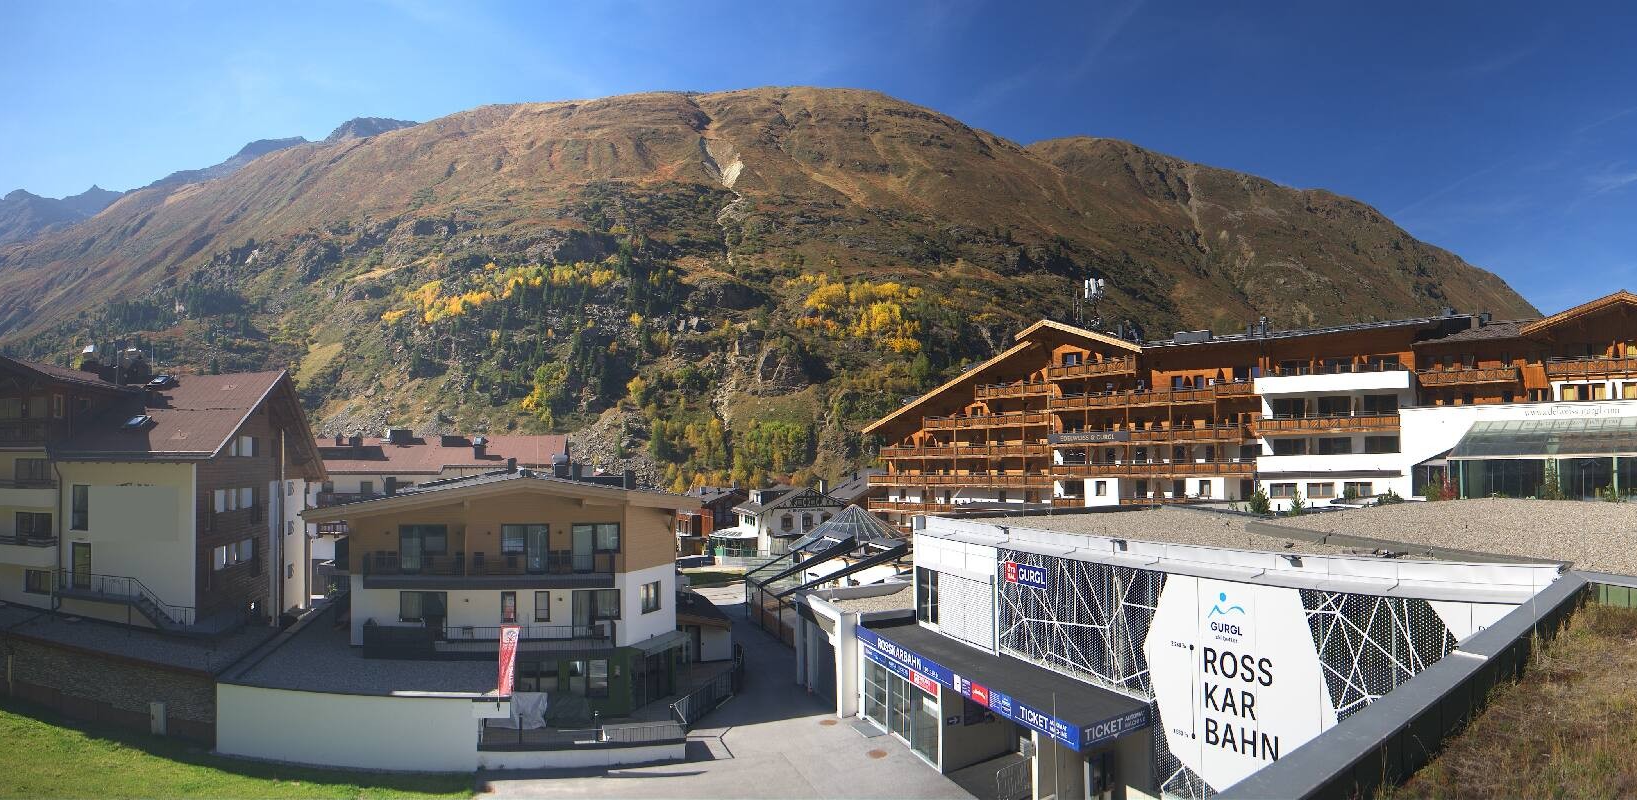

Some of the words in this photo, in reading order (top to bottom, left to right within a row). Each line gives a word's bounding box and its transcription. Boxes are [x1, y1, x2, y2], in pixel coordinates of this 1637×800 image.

[1018, 567, 1046, 585] GURGL
[1210, 621, 1243, 636] GURGL
[877, 637, 922, 671] ROSSKARBAHN
[1203, 646, 1273, 687] ROSS
[1204, 682, 1257, 721] KAR
[1019, 705, 1049, 730] TICKET
[1085, 717, 1124, 741] TICKET
[1205, 717, 1279, 762] BAHN
